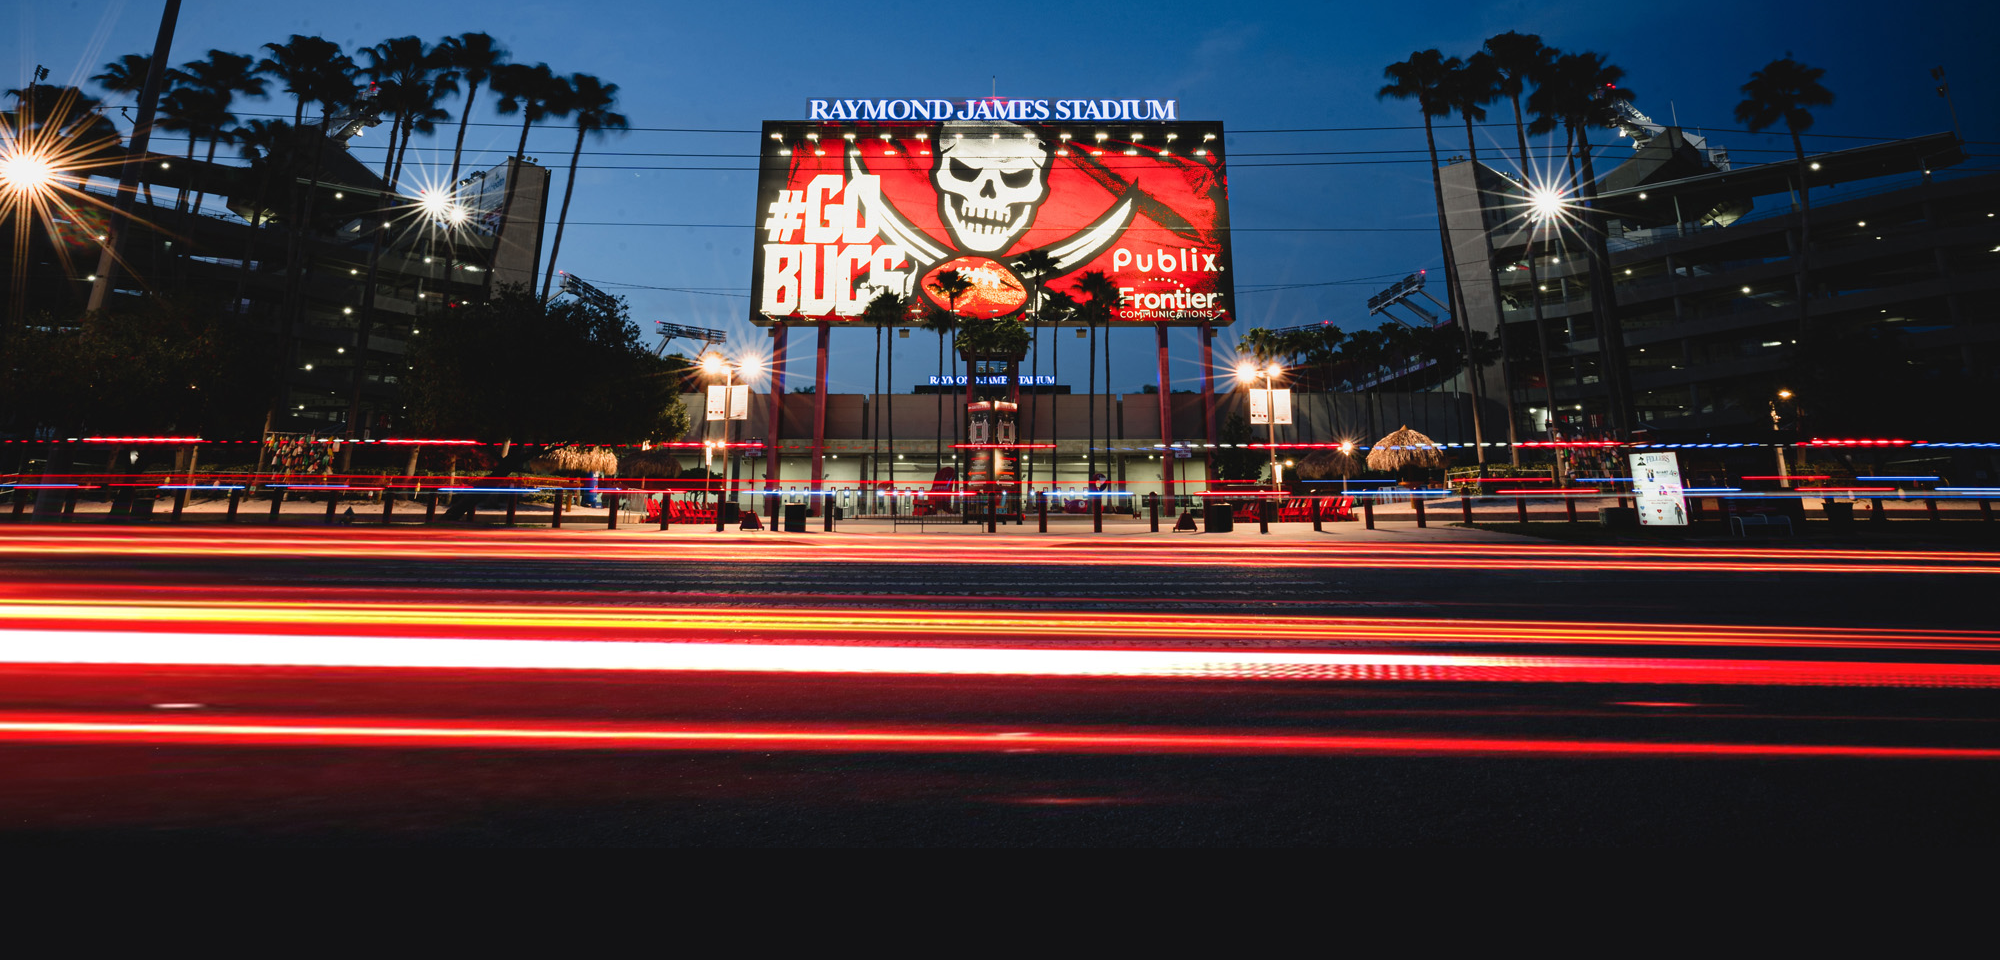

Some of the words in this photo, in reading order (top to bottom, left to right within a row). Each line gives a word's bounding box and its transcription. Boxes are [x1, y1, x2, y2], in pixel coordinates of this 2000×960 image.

[810, 99, 953, 120] RAYMOND
[957, 99, 1050, 121] JAMES
[1055, 99, 1177, 120] STADIUM
[764, 174, 881, 244] #GO
[761, 243, 906, 316] BUCS
[1119, 287, 1217, 309] Frontier
[1119, 310, 1213, 319] COMMUNICATIONS
